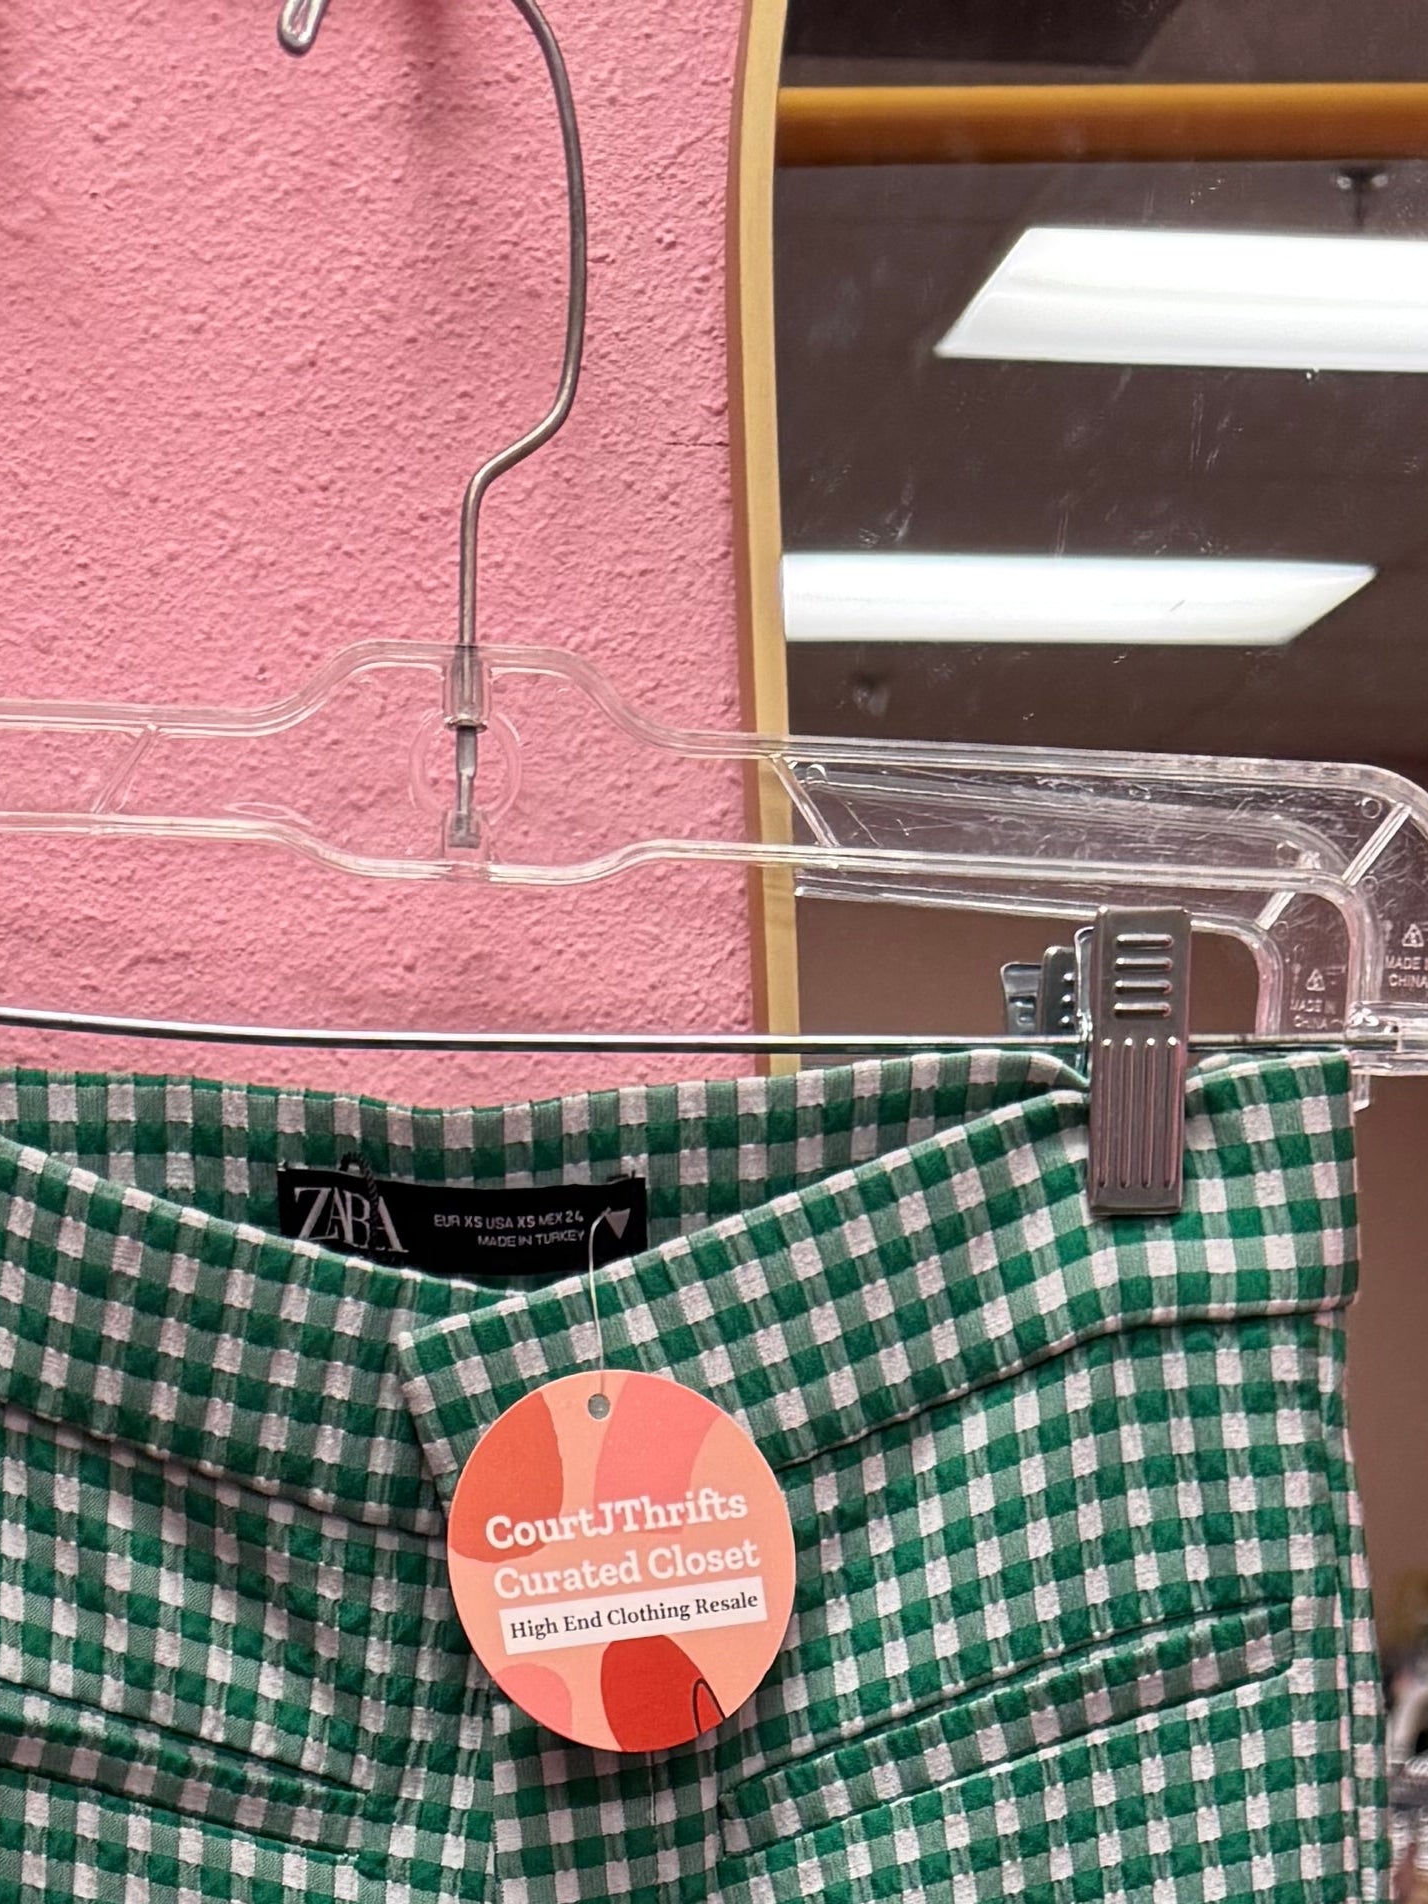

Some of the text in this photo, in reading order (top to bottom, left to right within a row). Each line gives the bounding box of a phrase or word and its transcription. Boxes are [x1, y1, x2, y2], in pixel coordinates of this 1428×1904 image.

[1384, 955, 1422, 970] MADE
[293, 1186, 410, 1254] ZARA
[433, 1214, 460, 1228] EUR
[464, 1216, 483, 1229] XS
[485, 1216, 514, 1230] USA
[517, 1215, 536, 1229] XS
[538, 1212, 563, 1226] MEX
[477, 1229, 586, 1248] MADE IN TURKEY
[484, 1487, 748, 1550] CourtJThrifts
[493, 1538, 761, 1600] Curated Closet
[510, 1591, 759, 1641] High End Clothing Resale
